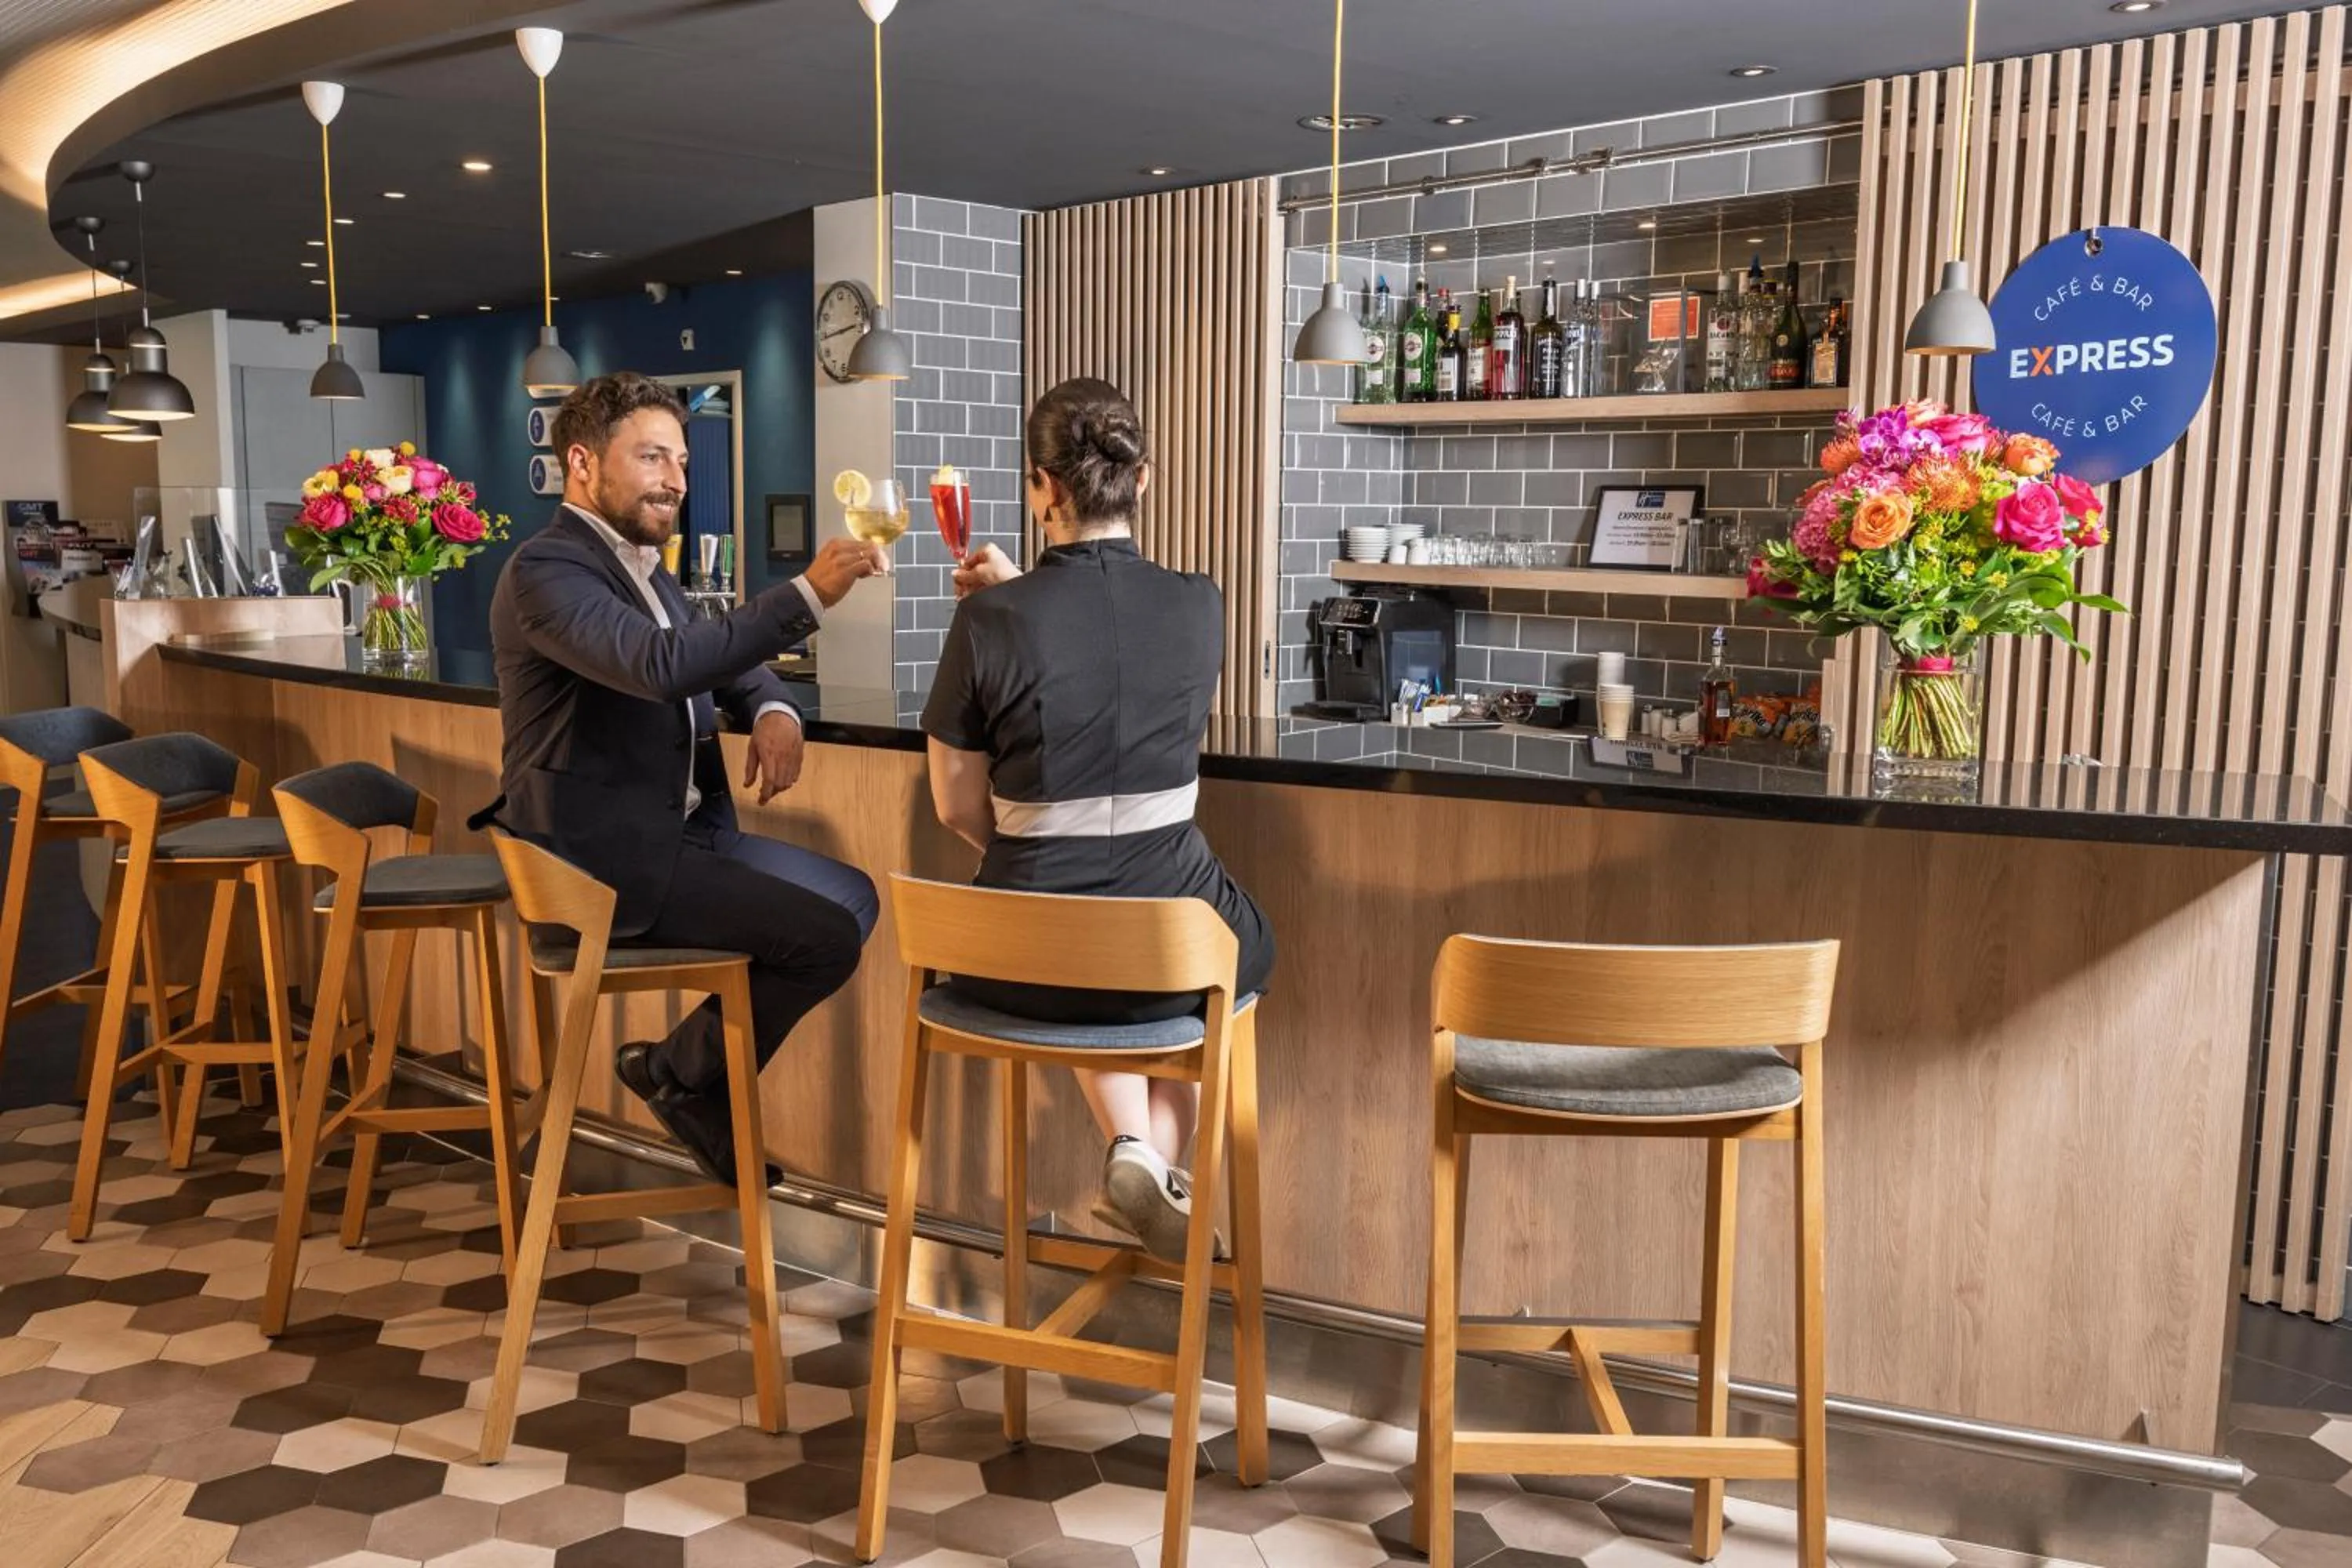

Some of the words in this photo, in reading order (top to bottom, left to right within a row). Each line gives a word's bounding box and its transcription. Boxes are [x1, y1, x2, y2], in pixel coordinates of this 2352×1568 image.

[2034, 276, 2081, 321] CAFÉ
[2089, 274, 2104, 292] &
[2113, 277, 2152, 312] BAR
[2009, 333, 2176, 379] EXPRESS
[2031, 402, 2076, 437] CAFÉ
[2082, 421, 2096, 438] &
[2104, 394, 2149, 433] BAR
[1617, 511, 1653, 521] EXPRESS
[1655, 511, 1674, 521] BAR
